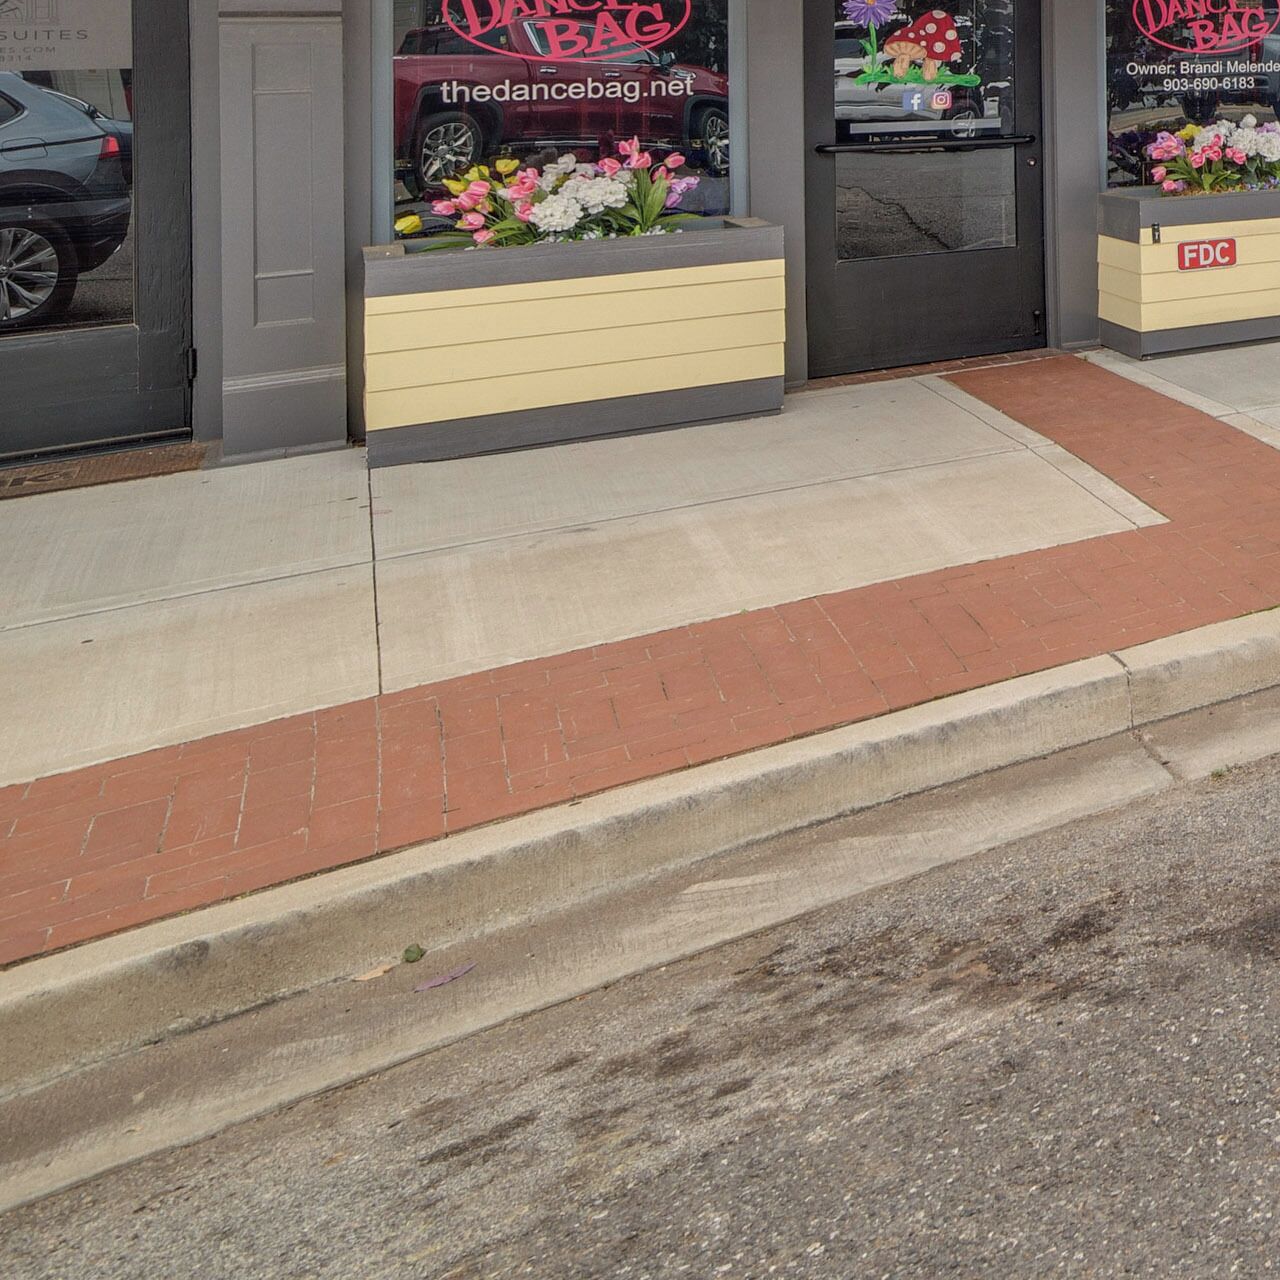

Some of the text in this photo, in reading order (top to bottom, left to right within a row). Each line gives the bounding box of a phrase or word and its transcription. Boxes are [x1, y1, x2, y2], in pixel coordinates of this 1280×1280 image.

[0, 30, 88, 40] SUITES
[536, 3, 671, 58] BAG
[1187, 8, 1270, 51] BAG
[1126, 62, 1176, 75] Owner:
[1180, 61, 1223, 74] Brandi
[440, 77, 695, 103] thedancebag.net
[1163, 77, 1255, 91] 903-690-6183
[1183, 241, 1230, 268] FDC
